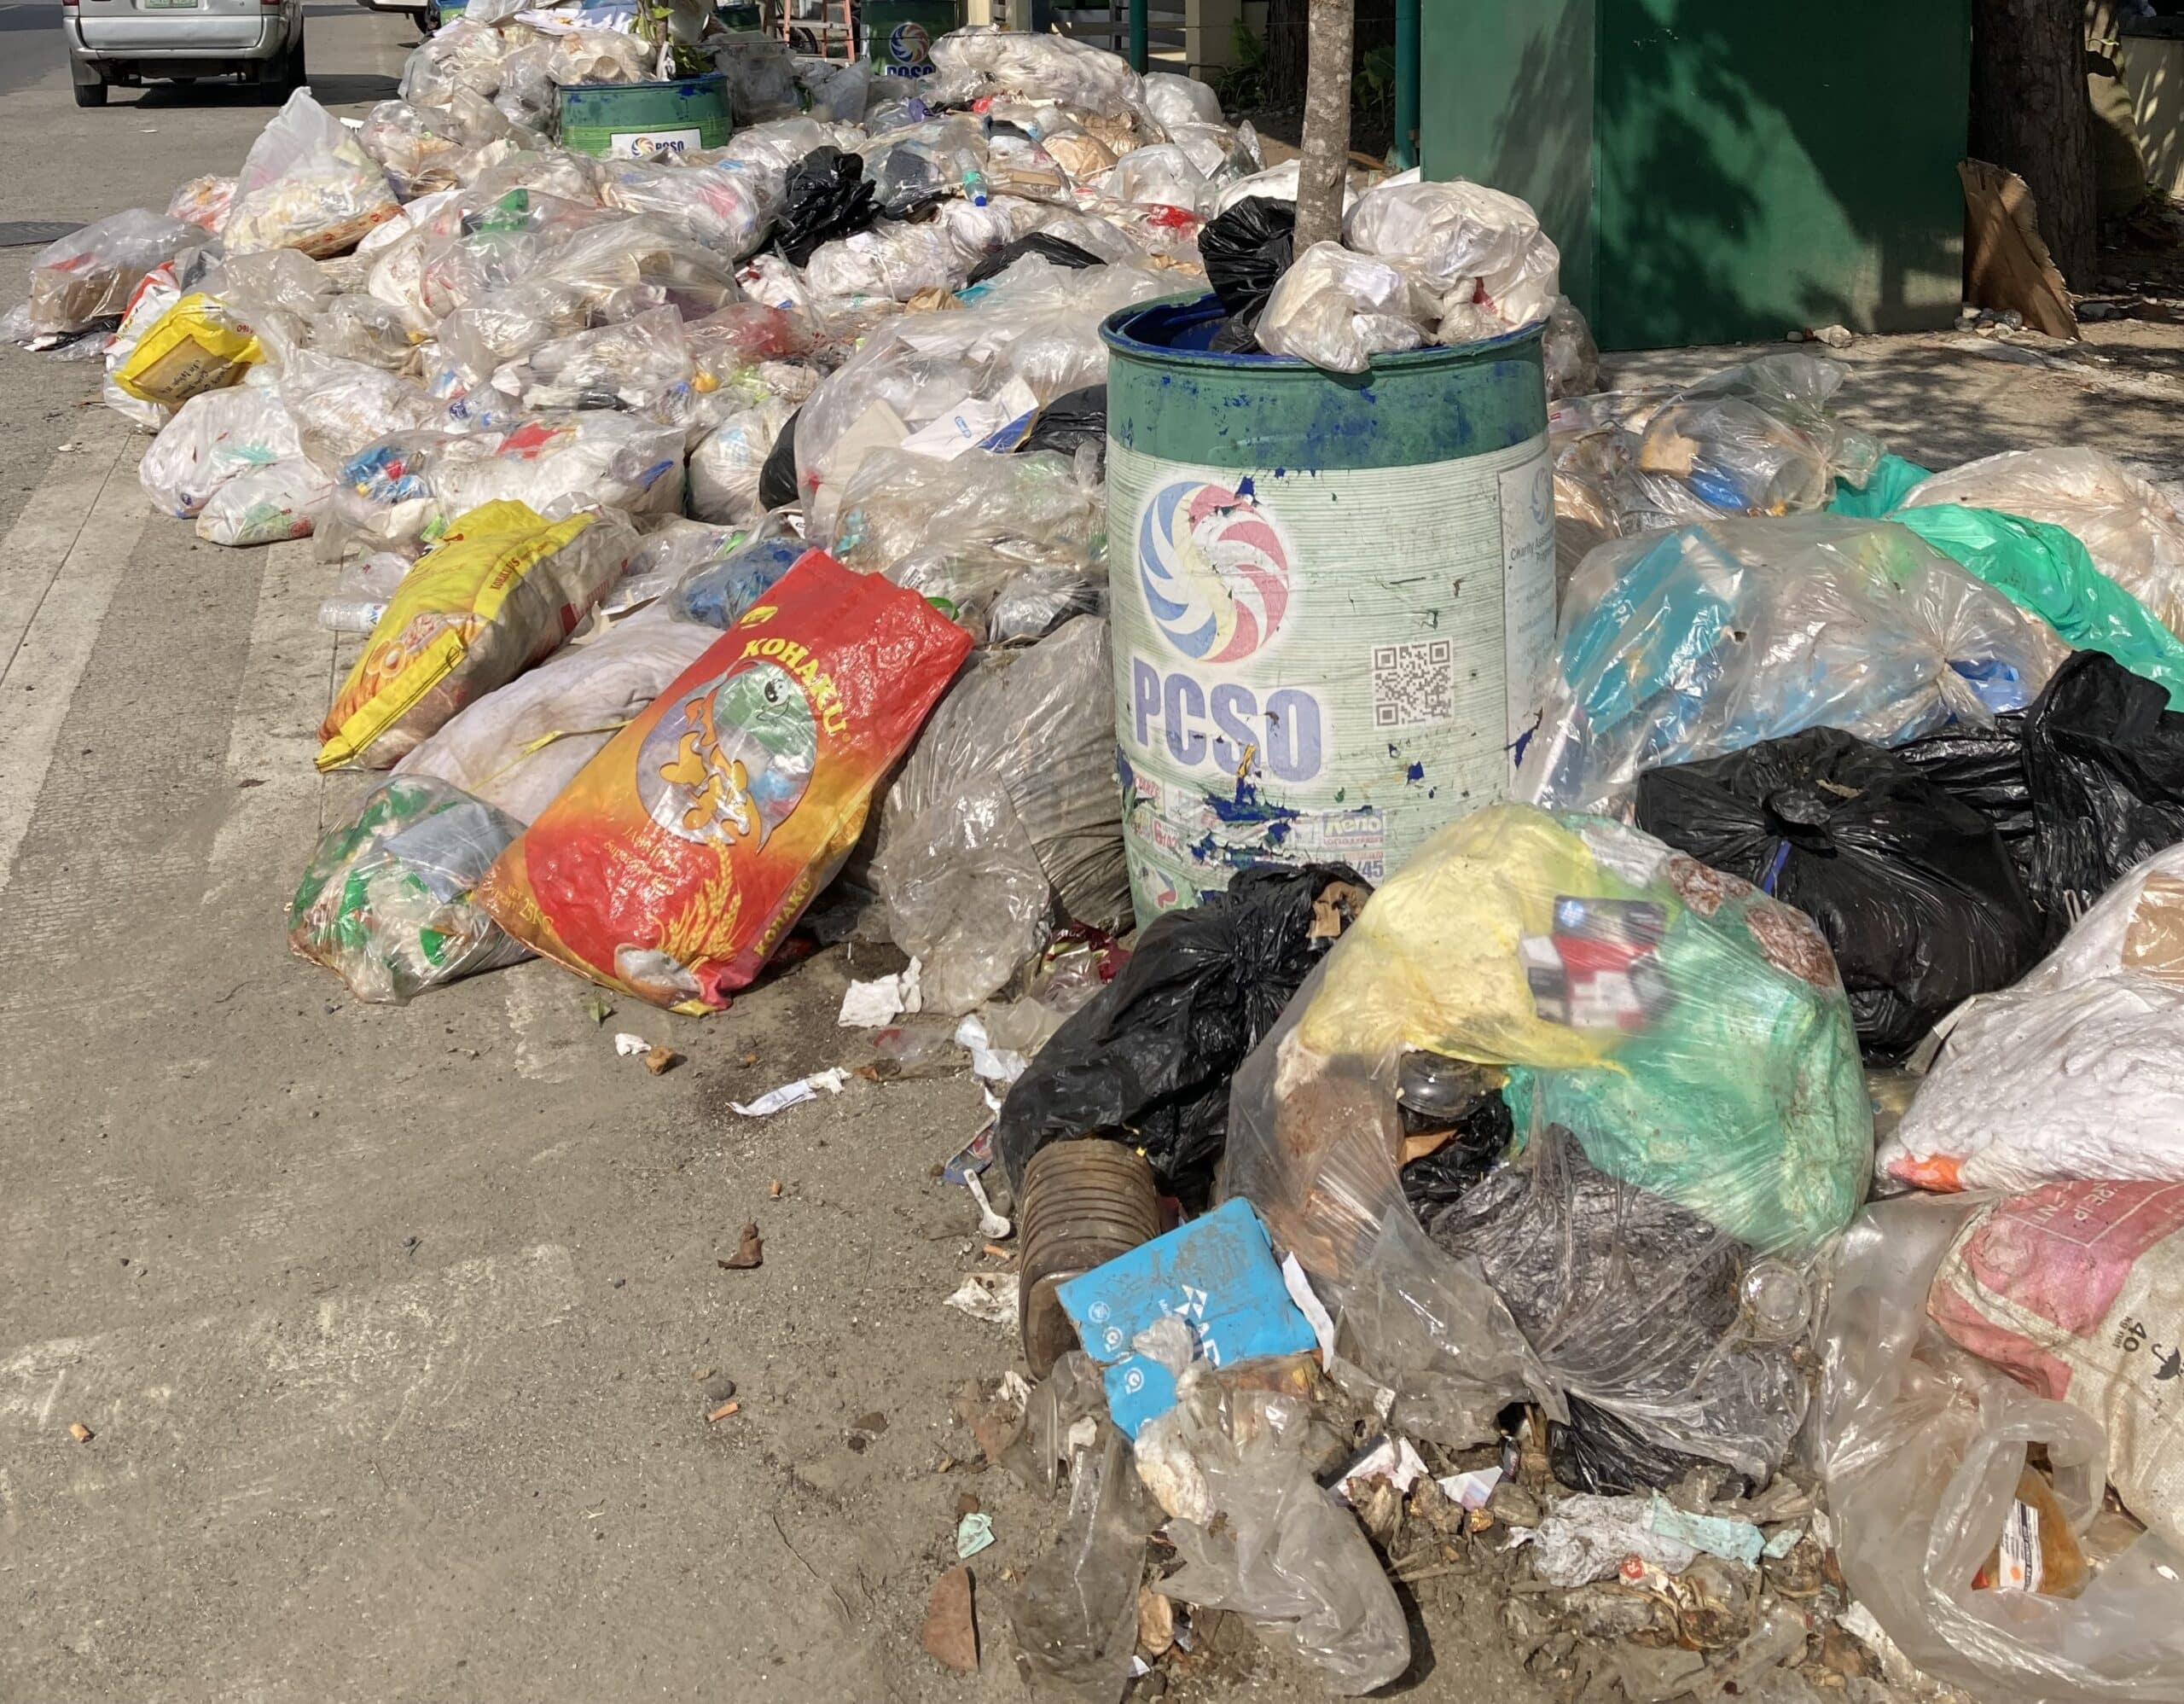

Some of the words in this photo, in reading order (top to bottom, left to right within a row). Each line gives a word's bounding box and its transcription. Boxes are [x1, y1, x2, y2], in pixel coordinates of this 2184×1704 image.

[738, 637, 847, 737] KOHAKU
[1133, 656, 1321, 782] PCSO
[1356, 860, 1384, 878] /45
[2123, 1322, 2147, 1352] 40
